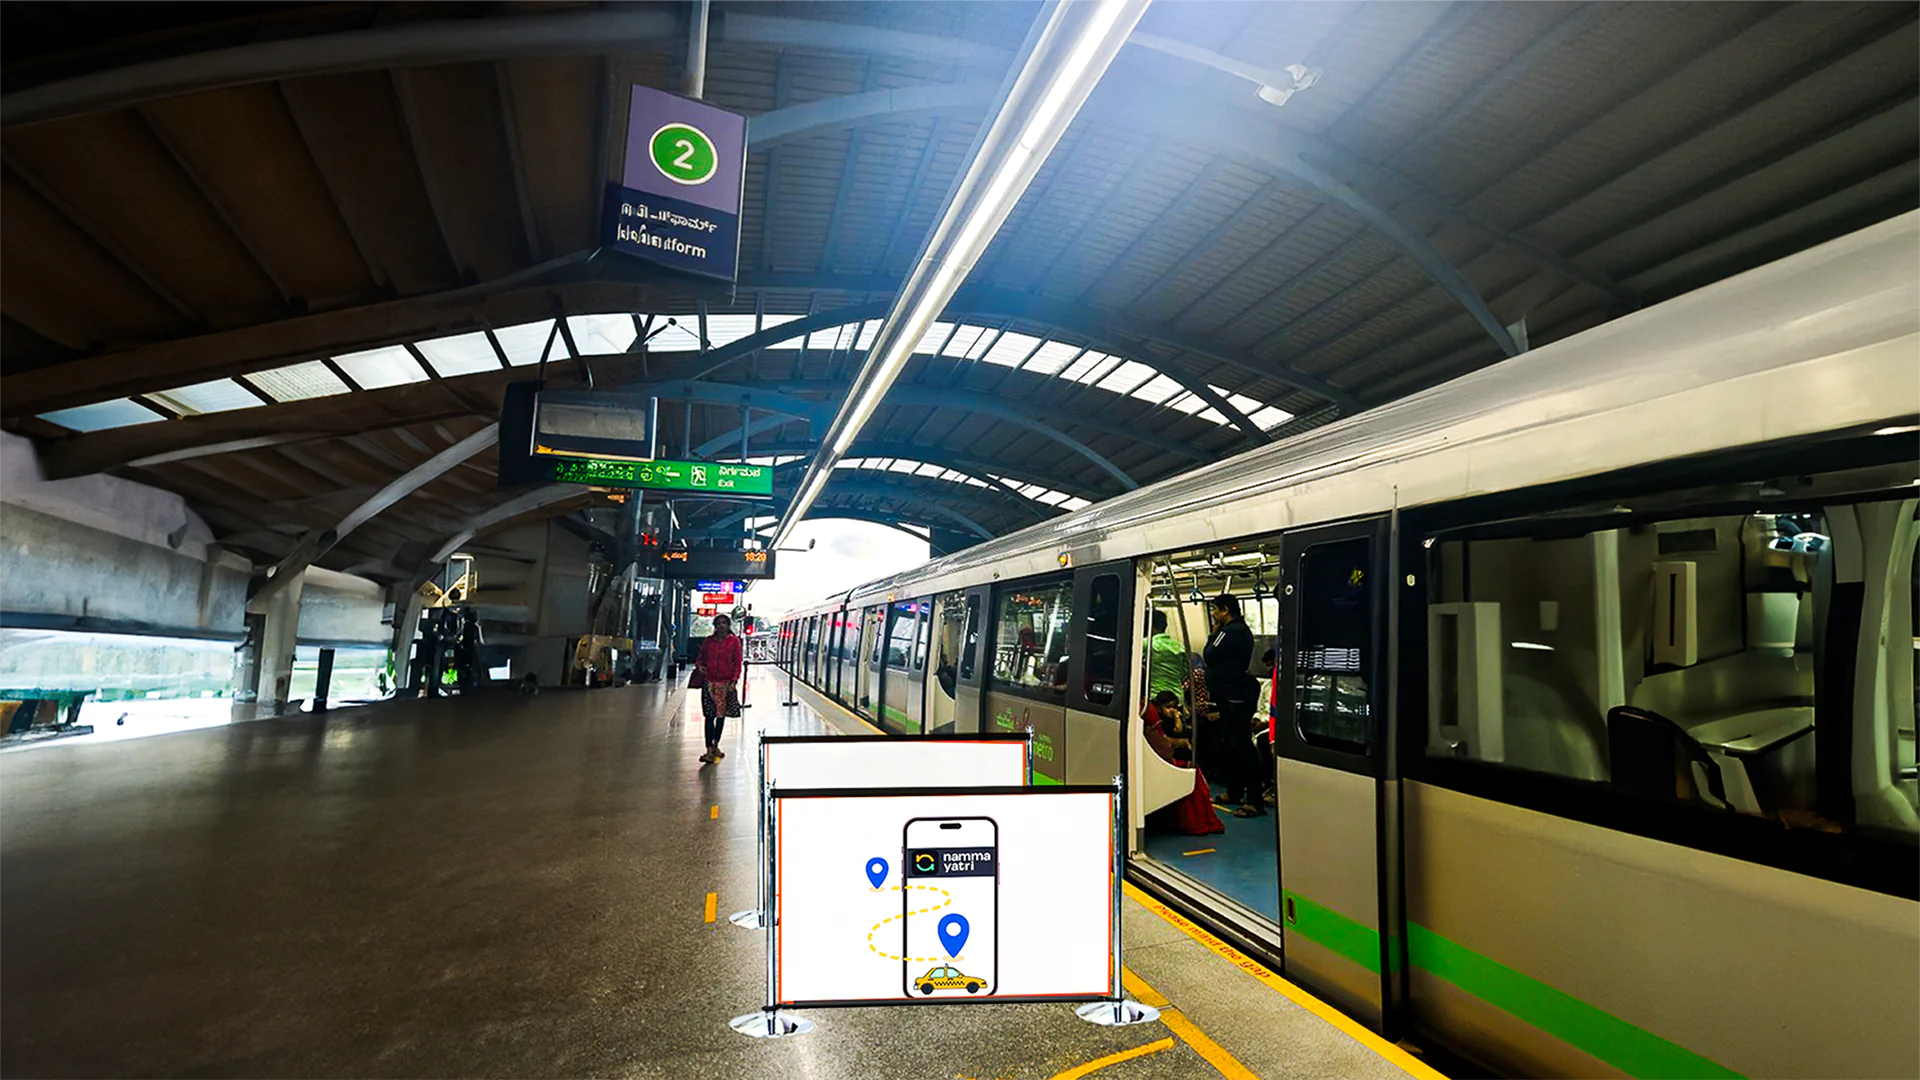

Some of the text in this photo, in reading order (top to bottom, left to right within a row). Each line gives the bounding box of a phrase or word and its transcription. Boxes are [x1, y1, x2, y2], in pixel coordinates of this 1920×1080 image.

[672, 139, 695, 170] 2
[718, 479, 734, 488] Exit
[943, 852, 991, 862] namma
[943, 861, 974, 873] yatri
[1188, 927, 1222, 946] mind
[1219, 946, 1242, 960] the
[1239, 961, 1271, 978] gap
